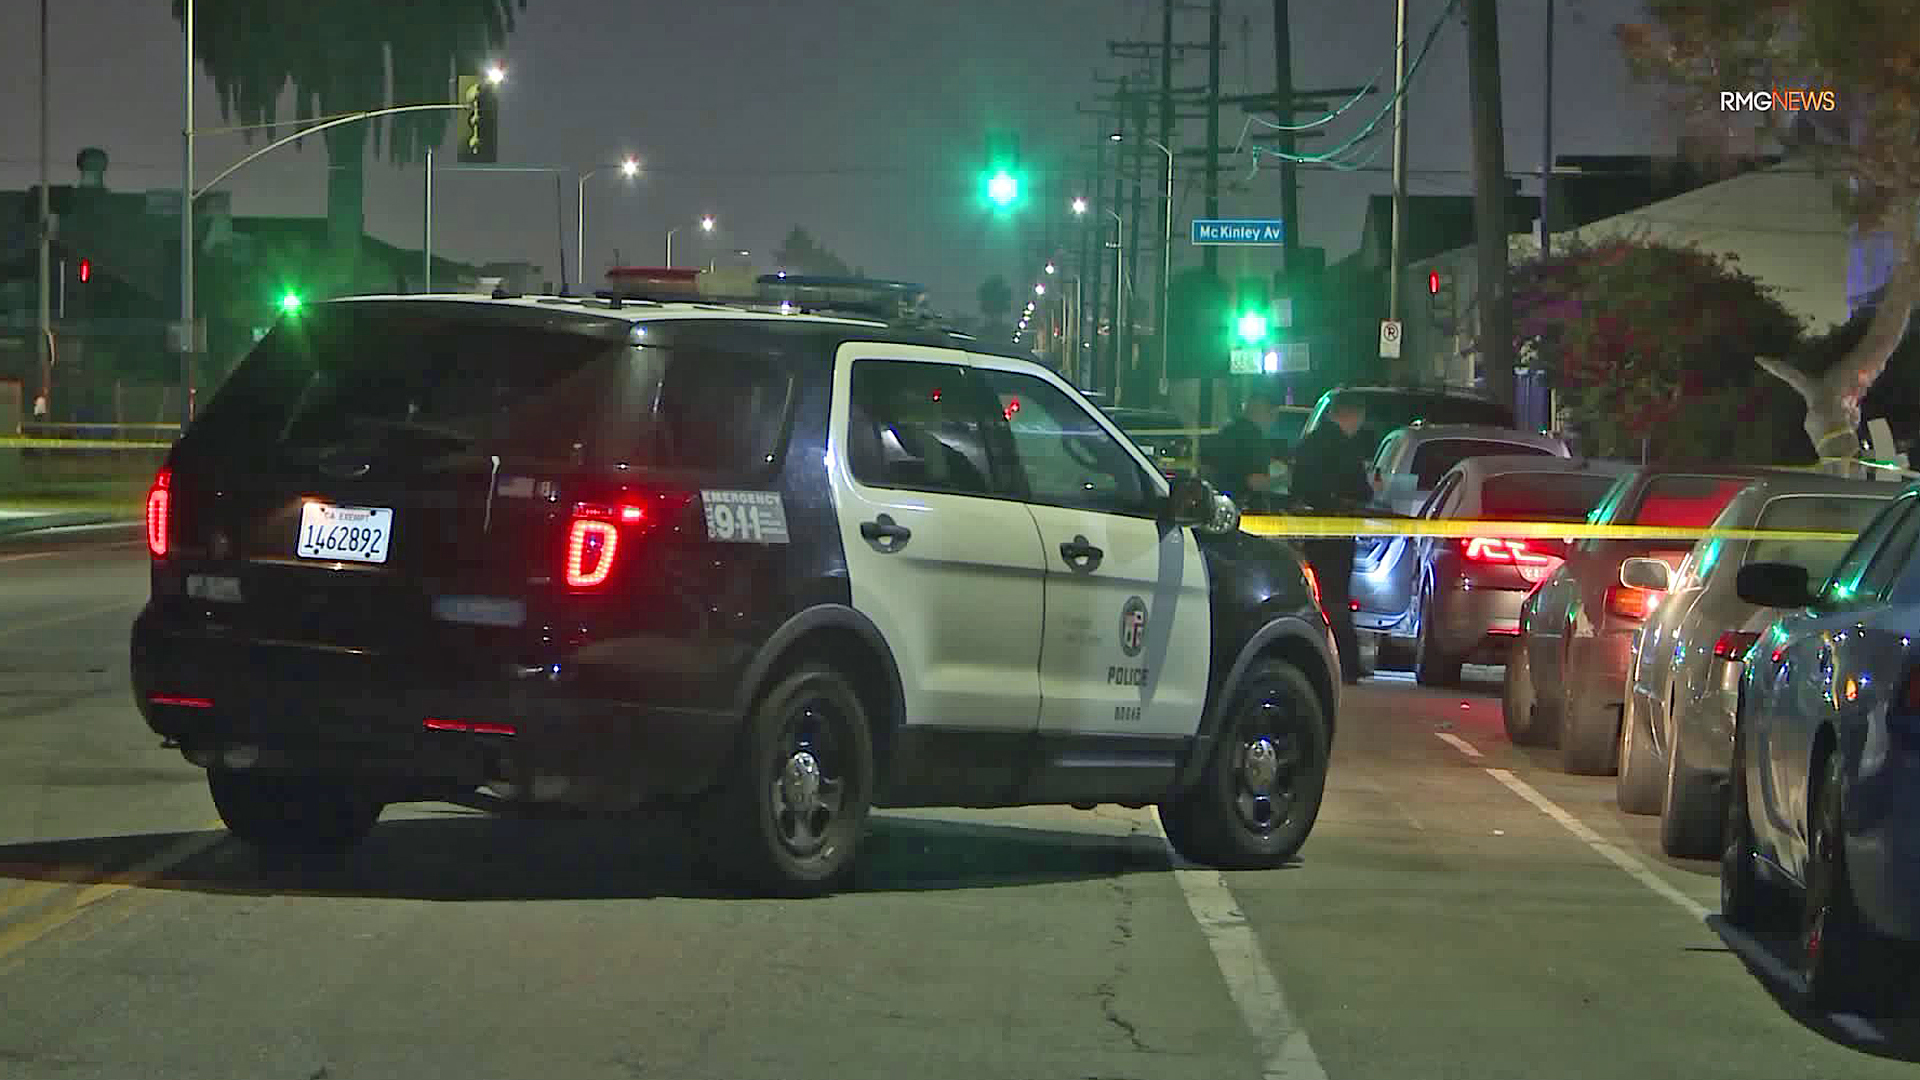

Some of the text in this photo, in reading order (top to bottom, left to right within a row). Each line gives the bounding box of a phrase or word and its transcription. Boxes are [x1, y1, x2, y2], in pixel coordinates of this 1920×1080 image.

[1200, 225, 1280, 241] McKinley Av
[701, 491, 781, 506] EMERGENCY
[304, 525, 382, 553] 1462892
[1107, 666, 1149, 687] POLICE
